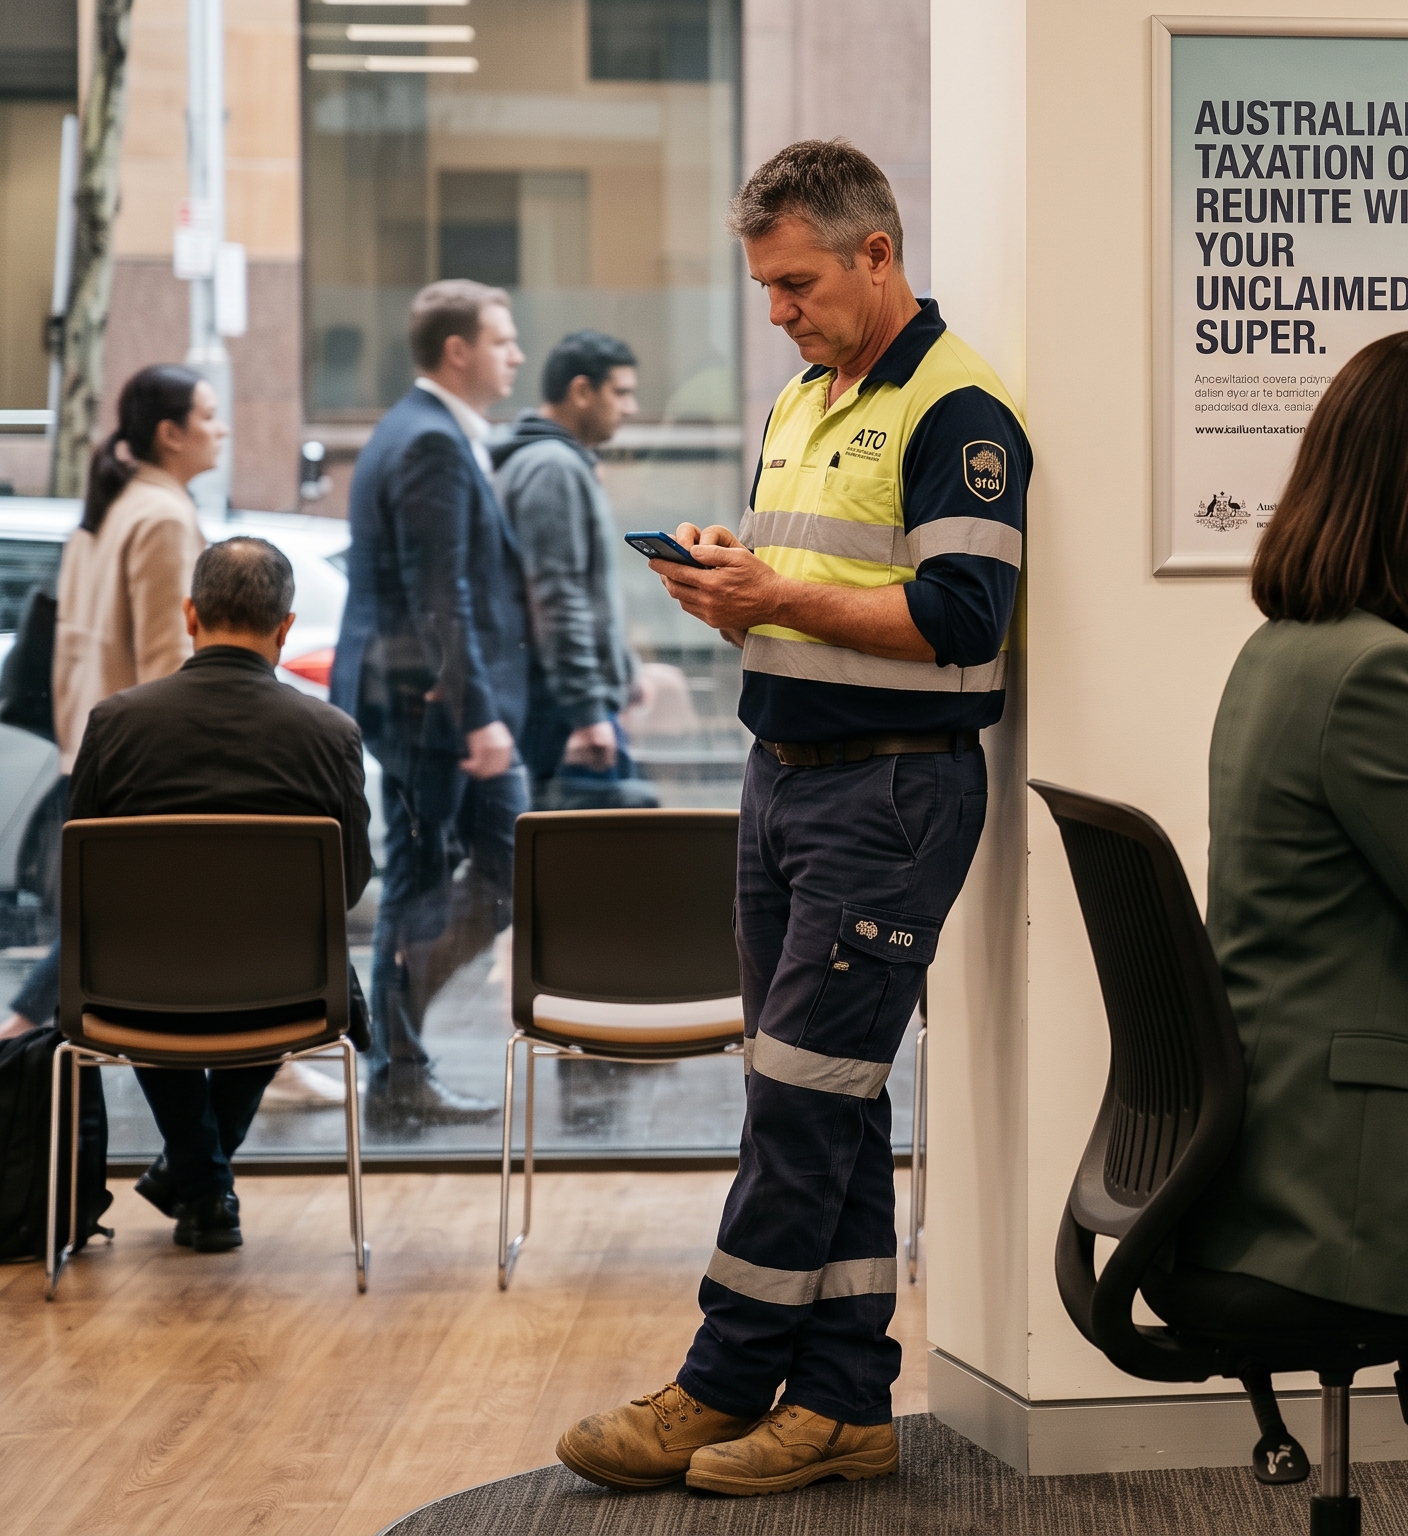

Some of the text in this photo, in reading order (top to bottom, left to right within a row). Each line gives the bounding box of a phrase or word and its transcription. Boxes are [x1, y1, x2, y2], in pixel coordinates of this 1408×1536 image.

[1195, 143, 1374, 180] TAXATION
[1196, 188, 1352, 224] REUNITE
[1195, 231, 1295, 267] YOUR
[1195, 319, 1327, 355] SUPER.
[850, 428, 887, 450] ATO
[889, 930, 913, 947] ATO
